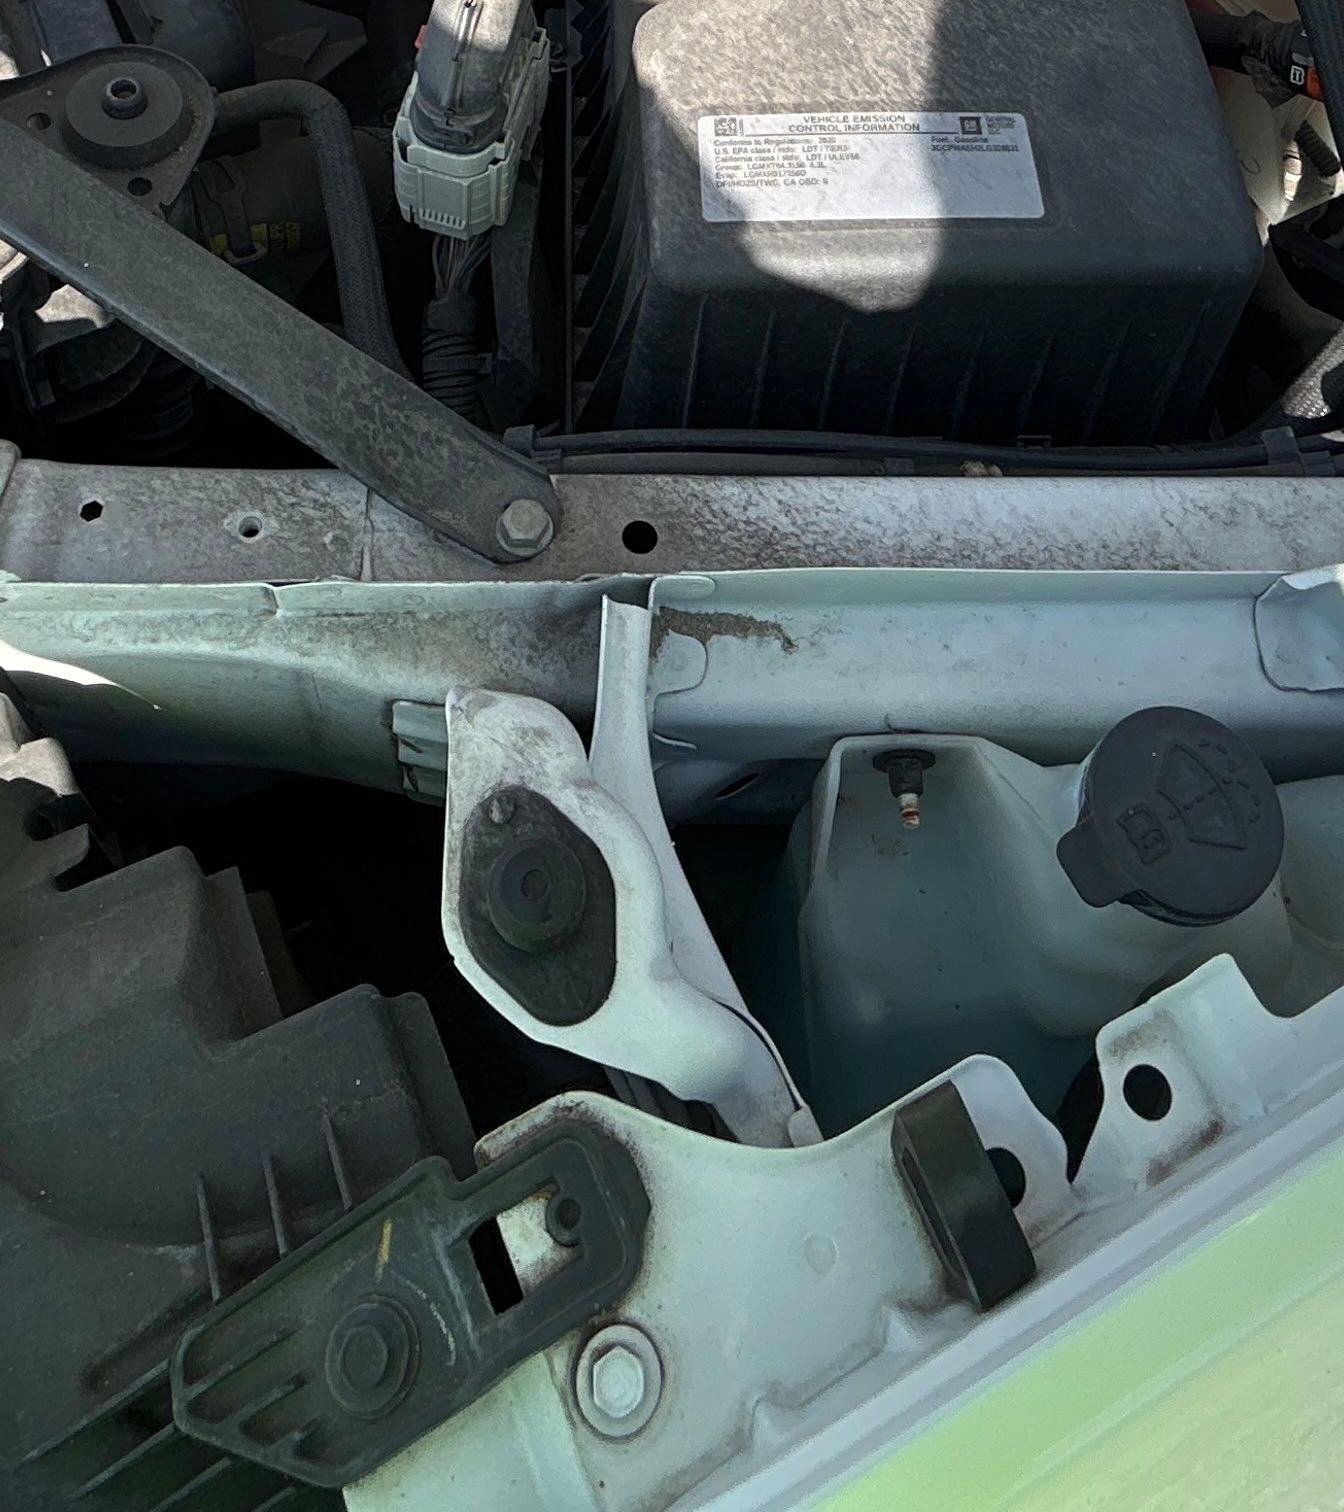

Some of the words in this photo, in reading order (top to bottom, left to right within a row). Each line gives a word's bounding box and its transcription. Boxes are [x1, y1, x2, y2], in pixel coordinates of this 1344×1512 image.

[803, 114, 849, 124] VEHICLE
[853, 114, 906, 123] EMISSION
[788, 124, 843, 133] CONTROL
[844, 123, 920, 132] INFORMATION
